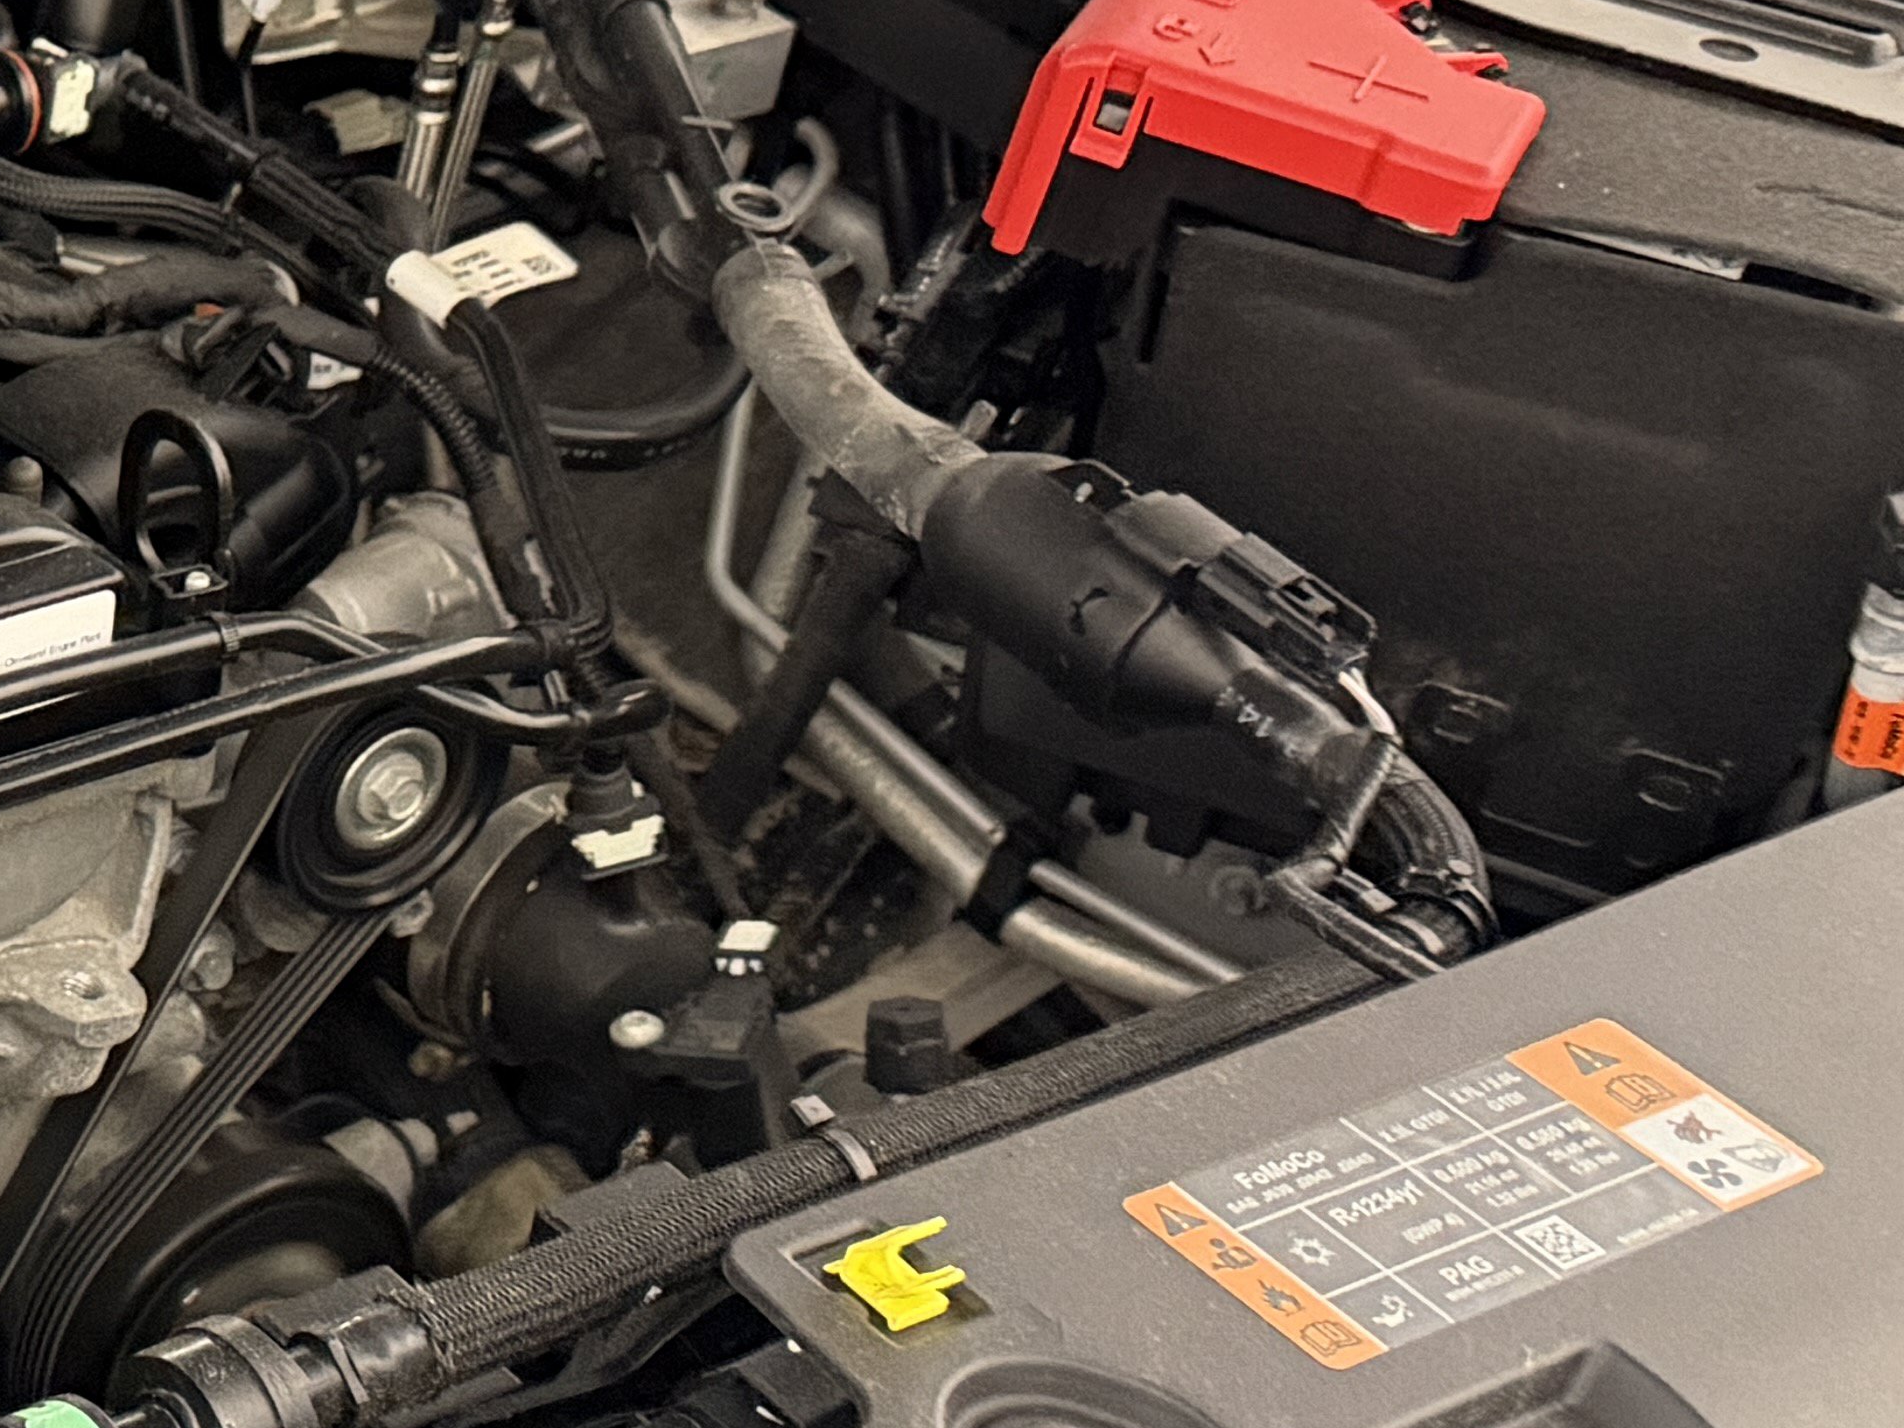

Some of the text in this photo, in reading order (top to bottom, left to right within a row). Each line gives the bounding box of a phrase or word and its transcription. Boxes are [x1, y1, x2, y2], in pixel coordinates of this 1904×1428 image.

[1560, 1118, 1592, 1136] kg
[1234, 1150, 1325, 1189] FoMoCo
[1479, 1150, 1510, 1169] kg
[1328, 1179, 1424, 1227] R-1234yf
[1440, 1255, 1494, 1284] PAG
